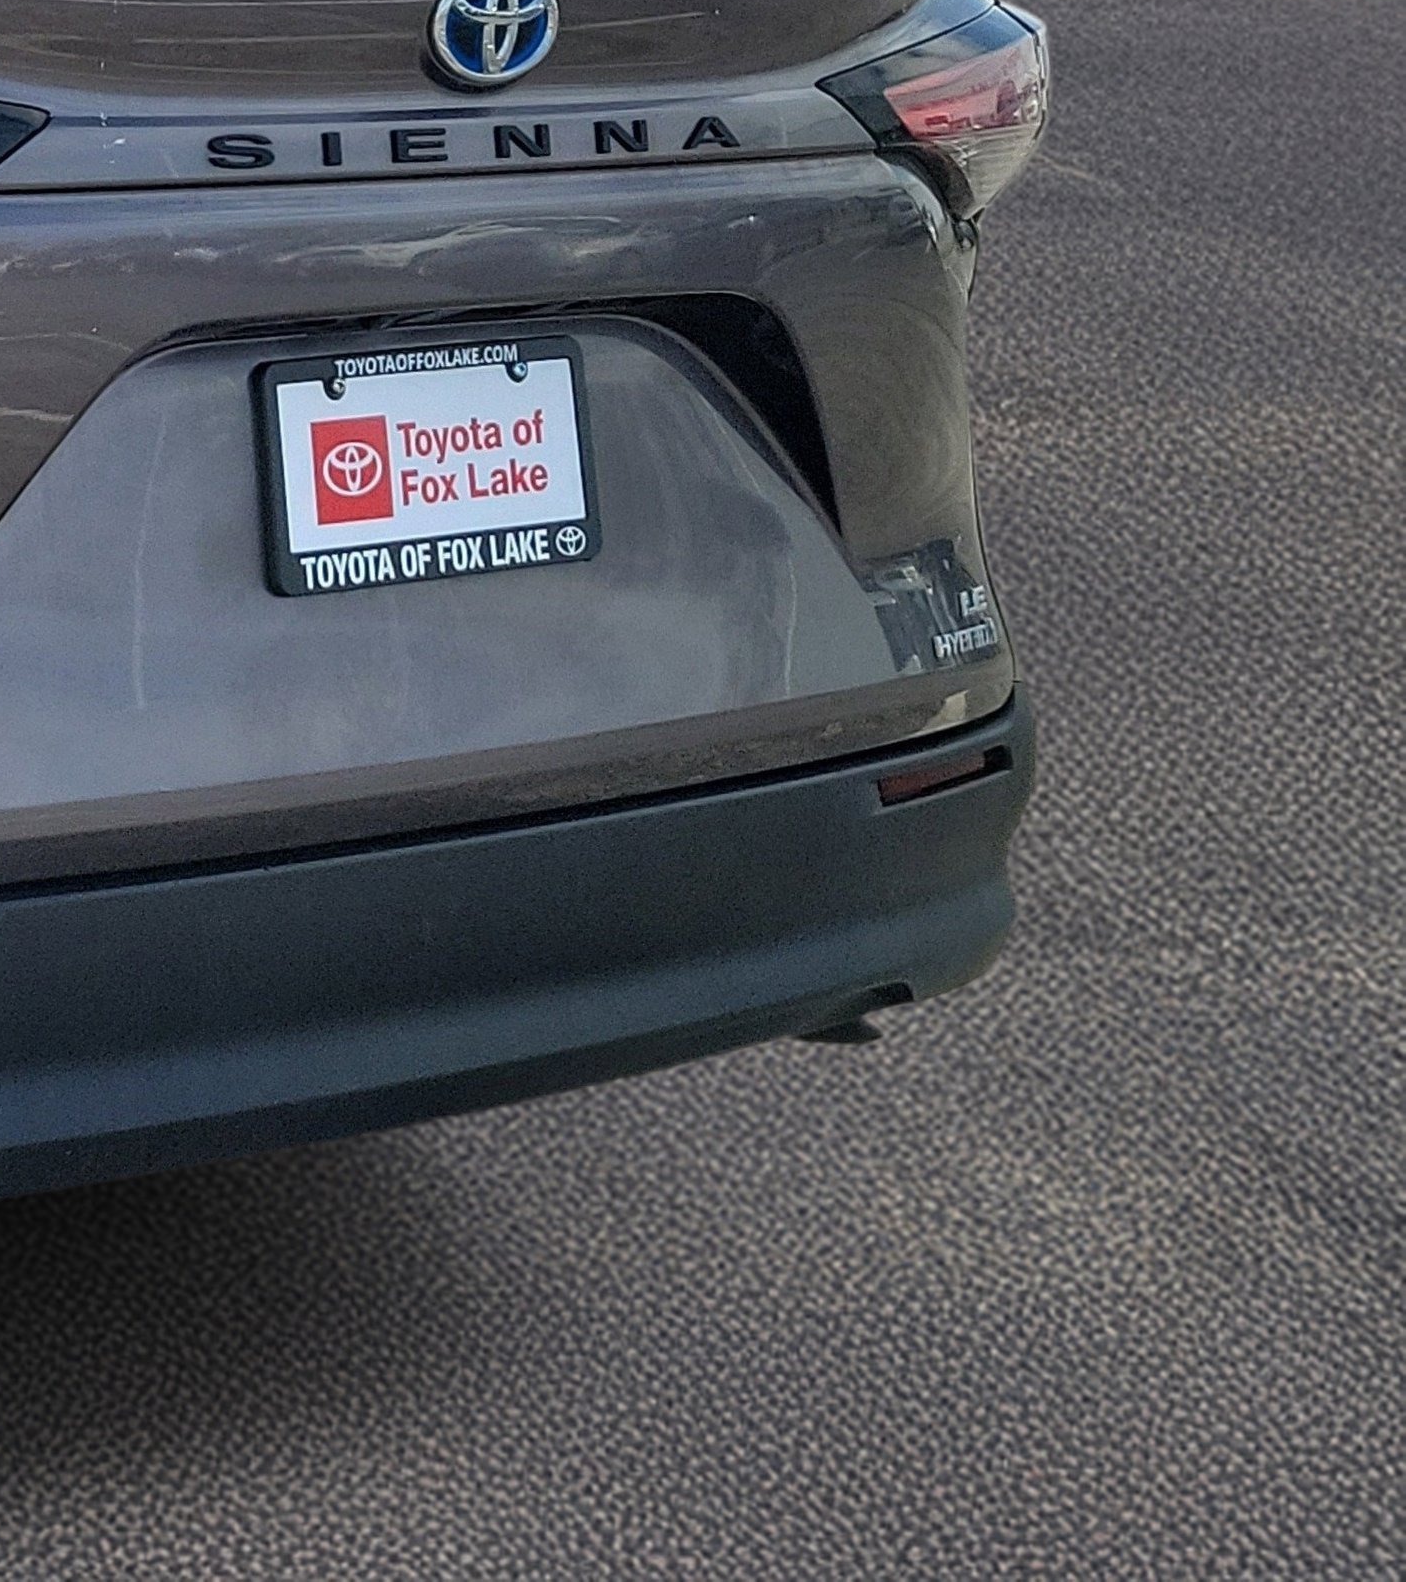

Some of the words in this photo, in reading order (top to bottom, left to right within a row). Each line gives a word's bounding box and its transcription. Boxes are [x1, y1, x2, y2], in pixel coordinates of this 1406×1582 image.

[206, 116, 741, 170] SIENNA
[334, 344, 519, 379] TOYOTAOFFOXLAKE.COM
[395, 418, 503, 464] Toyota
[512, 408, 544, 446] of
[400, 469, 460, 506] Fox
[467, 458, 550, 498] Lake
[299, 550, 396, 591] TOYOTA
[400, 542, 433, 579] OF
[436, 535, 486, 575] FOX
[489, 528, 551, 567] LAKE
[958, 584, 989, 618] LE
